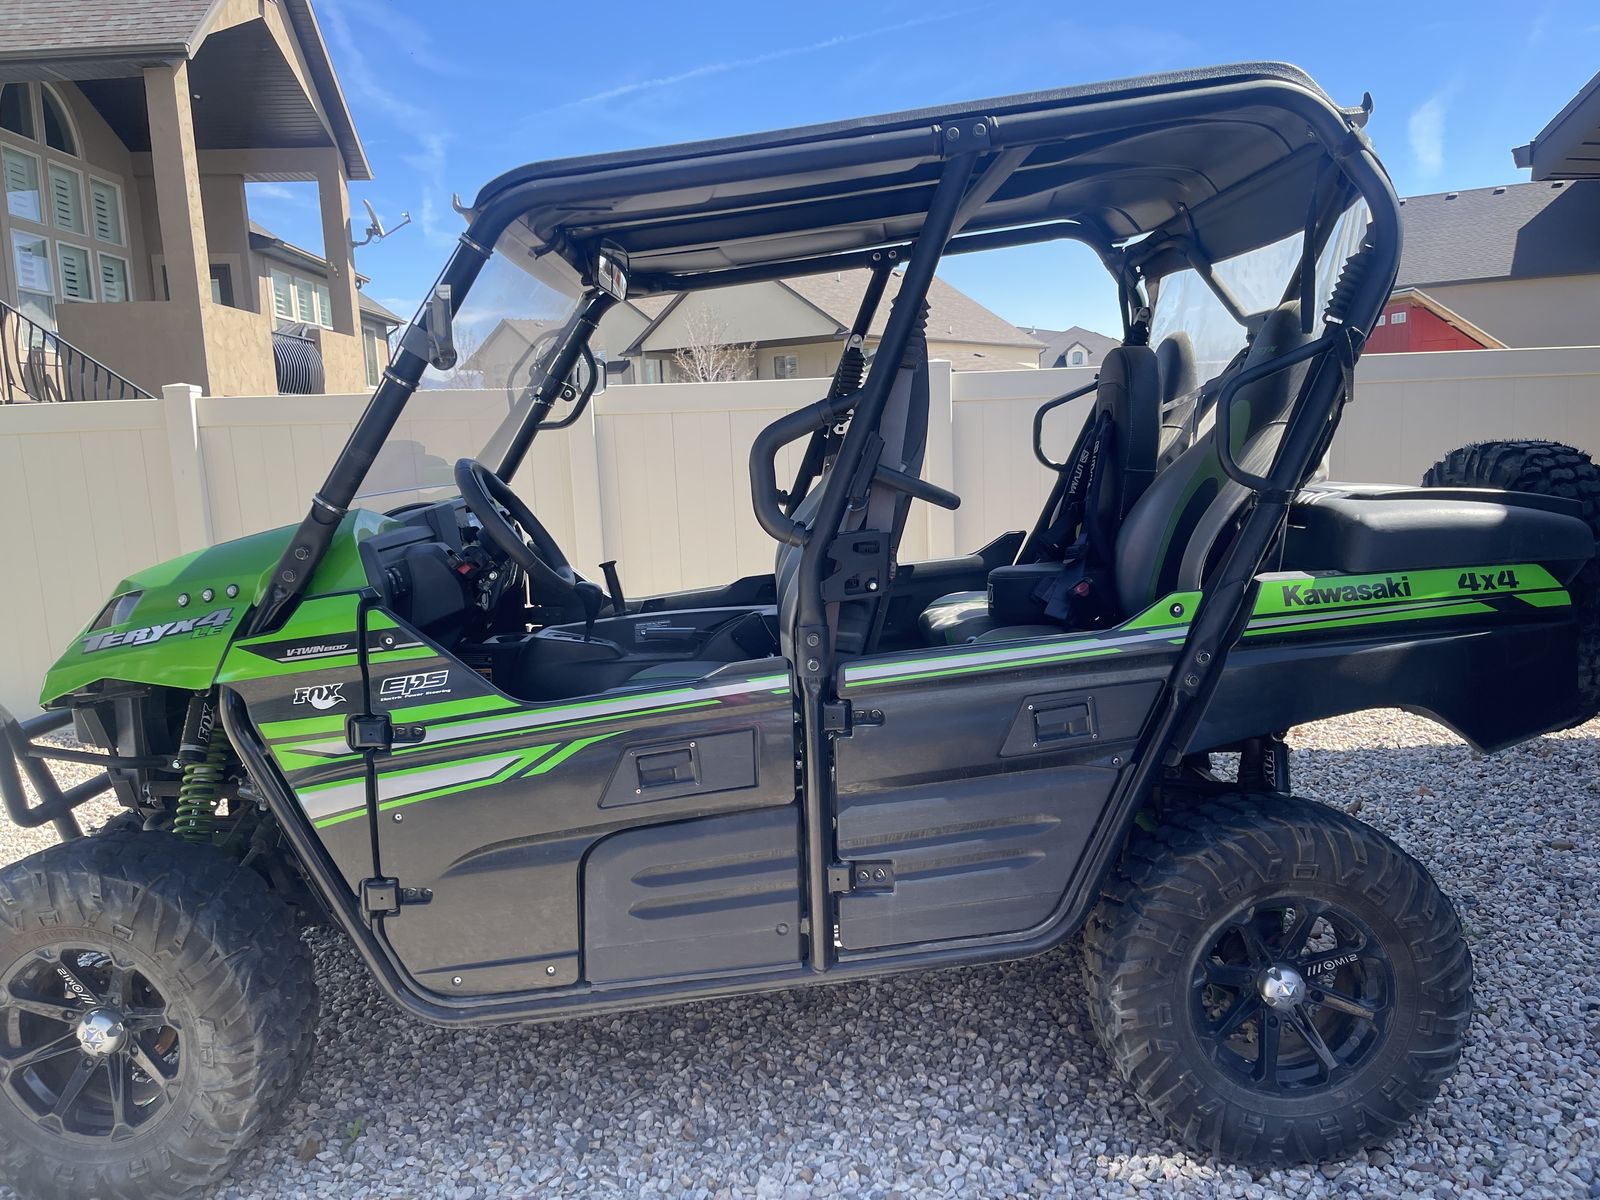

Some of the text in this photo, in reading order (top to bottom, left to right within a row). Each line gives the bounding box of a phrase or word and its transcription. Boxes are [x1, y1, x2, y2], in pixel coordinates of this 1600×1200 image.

[1281, 576, 1412, 607] Kawasaki
[1458, 570, 1520, 592] 4x4
[81, 607, 234, 655] TERYX4
[191, 624, 224, 639] LE
[293, 682, 347, 709] FOX
[380, 670, 449, 695] EPS
[197, 702, 216, 743] FOX
